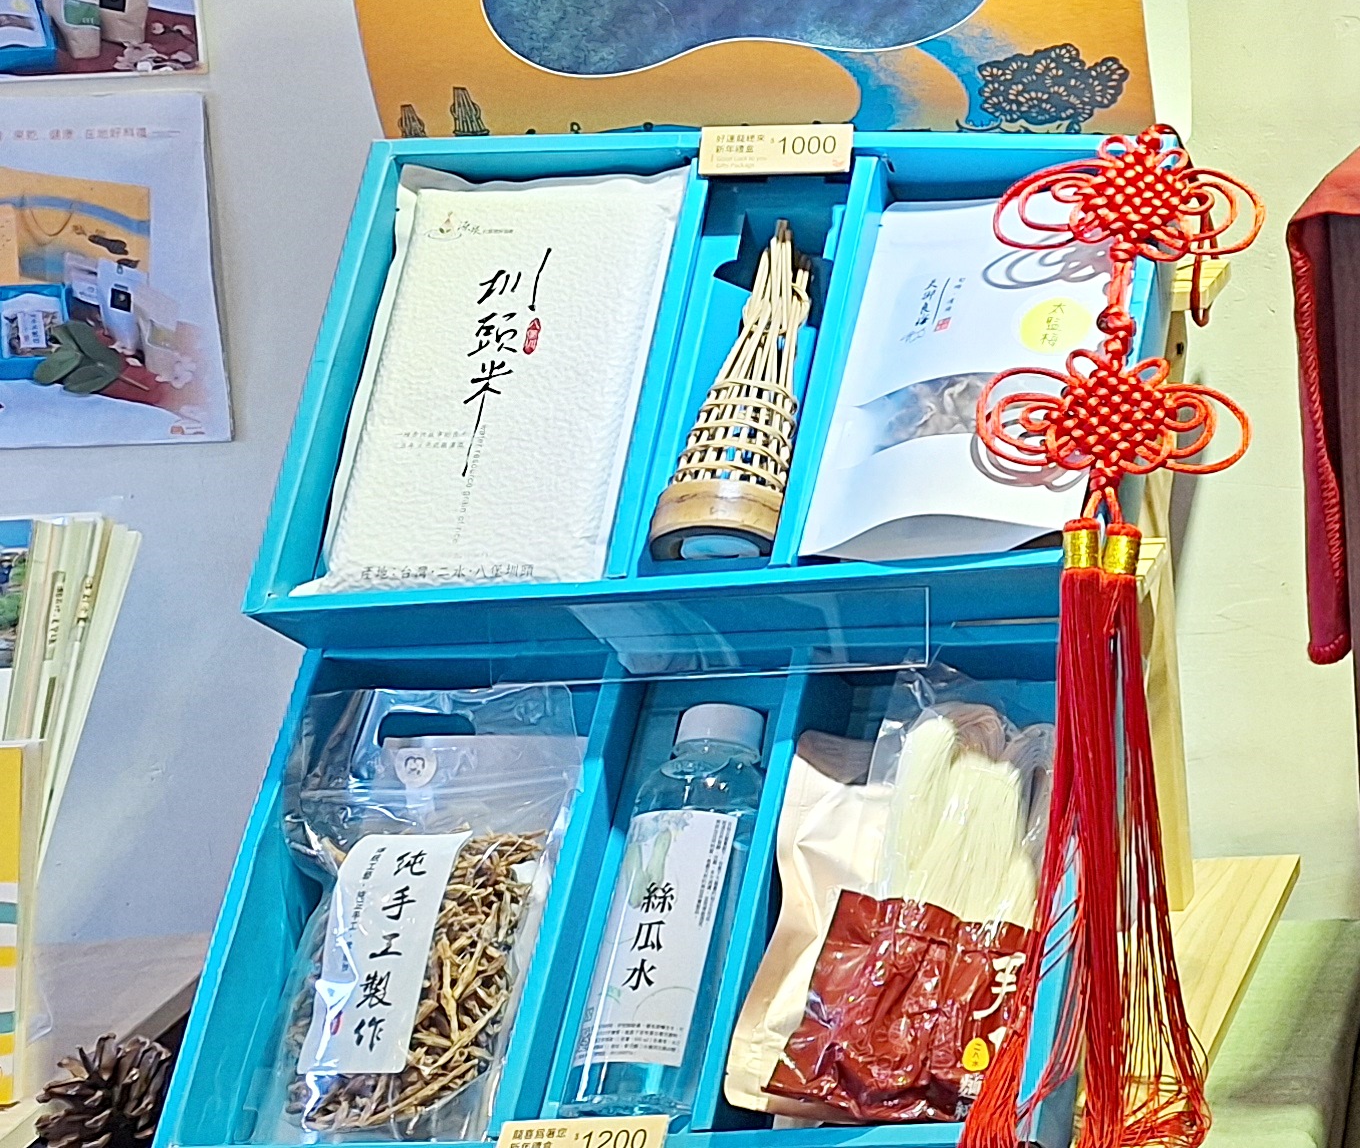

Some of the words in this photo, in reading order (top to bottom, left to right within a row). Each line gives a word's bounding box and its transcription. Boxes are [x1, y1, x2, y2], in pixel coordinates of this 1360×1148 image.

[777, 135, 838, 156] 1000
[621, 881, 676, 992] 絲瓜水
[582, 1128, 647, 1148] 1200
